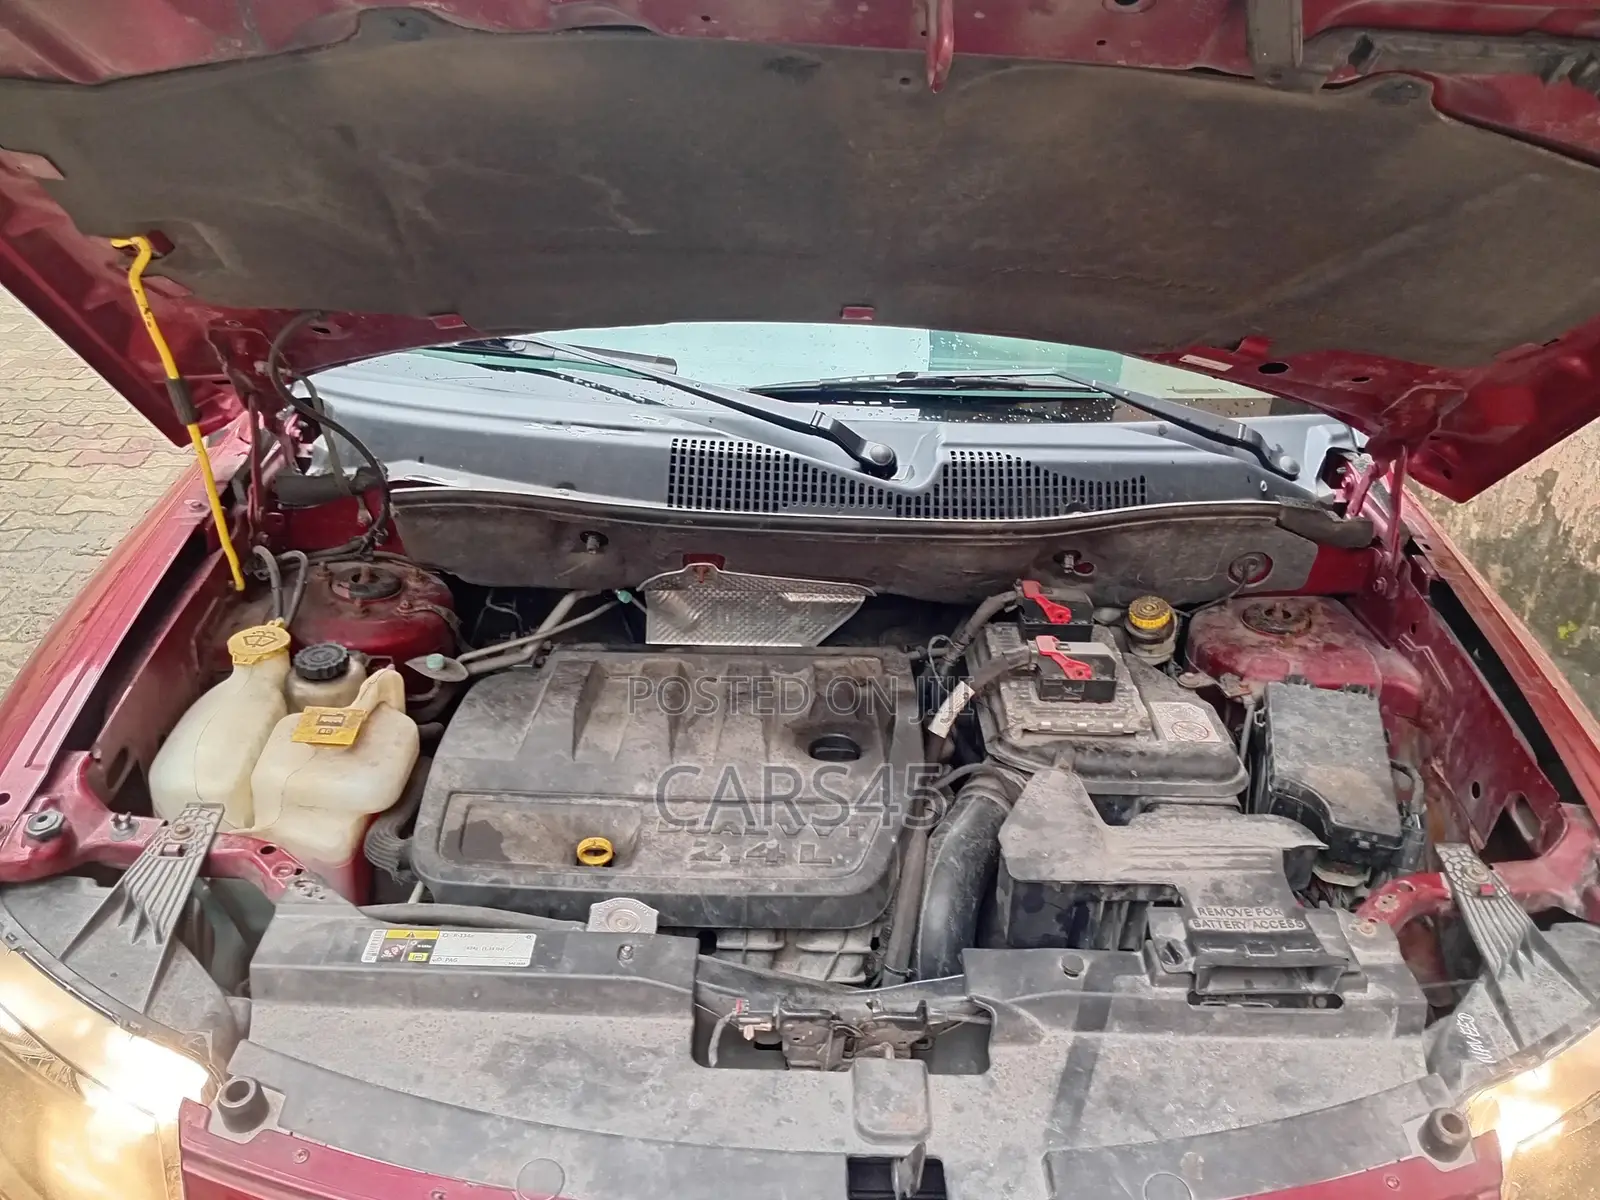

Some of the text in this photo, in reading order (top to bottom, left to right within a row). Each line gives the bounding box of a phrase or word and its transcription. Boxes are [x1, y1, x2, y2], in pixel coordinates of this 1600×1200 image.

[1197, 907, 1283, 917] REMOVE FOR
[1193, 919, 1304, 929] BATTERY ACCESS
